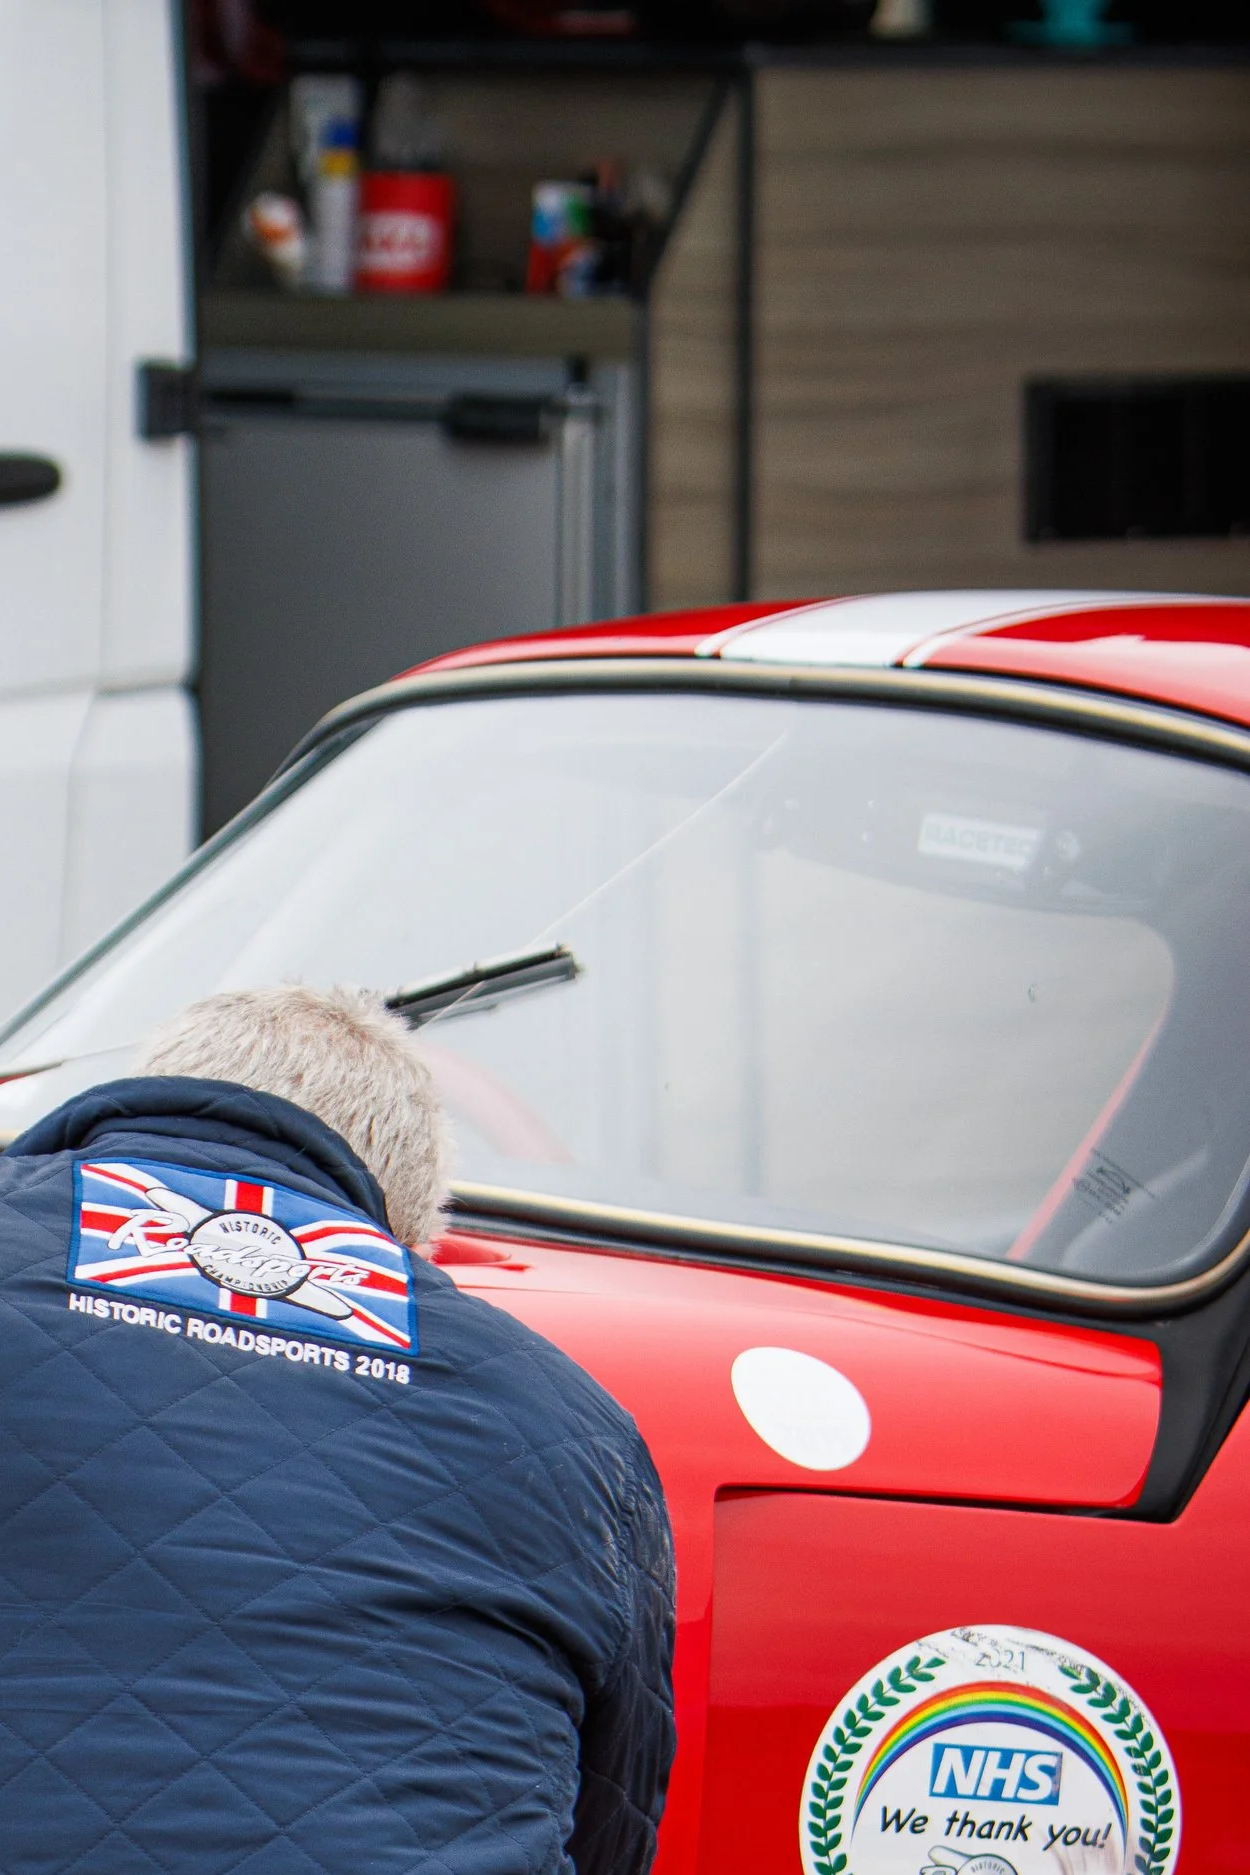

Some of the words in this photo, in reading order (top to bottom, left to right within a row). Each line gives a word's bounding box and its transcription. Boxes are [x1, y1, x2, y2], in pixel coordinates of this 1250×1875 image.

[107, 1208, 371, 1287] Roadsports
[219, 1220, 282, 1245] HISTORIC
[203, 1265, 289, 1293] CHAMPIONSHIP
[68, 1293, 182, 1334] HISTORIC
[186, 1318, 350, 1372] ROADSPORTS
[355, 1356, 410, 1385] 2018
[975, 1649, 1026, 1671] 2021
[932, 1748, 1059, 1801] NHS
[880, 1806, 929, 1834] We
[944, 1810, 1033, 1842] thank
[1042, 1823, 1112, 1852] you!
